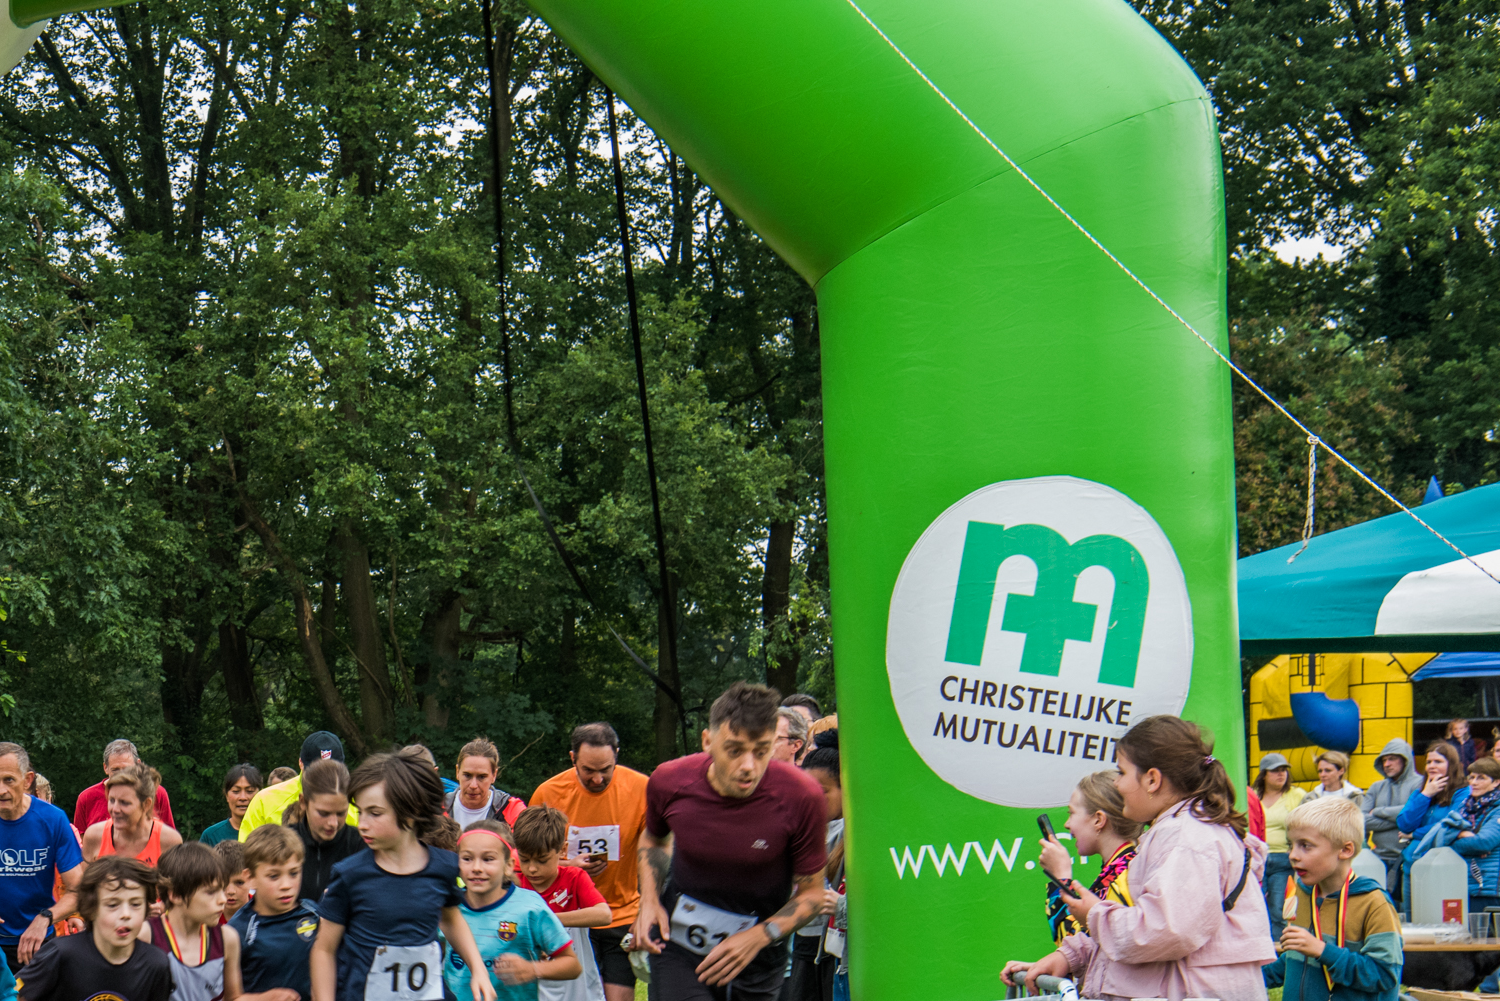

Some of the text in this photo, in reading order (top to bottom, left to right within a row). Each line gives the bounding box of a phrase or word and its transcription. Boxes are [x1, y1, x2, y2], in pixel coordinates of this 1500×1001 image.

[940, 675, 1132, 726] CHRISTELIJKE
[578, 838, 608, 854] 53
[384, 962, 428, 992] 10
